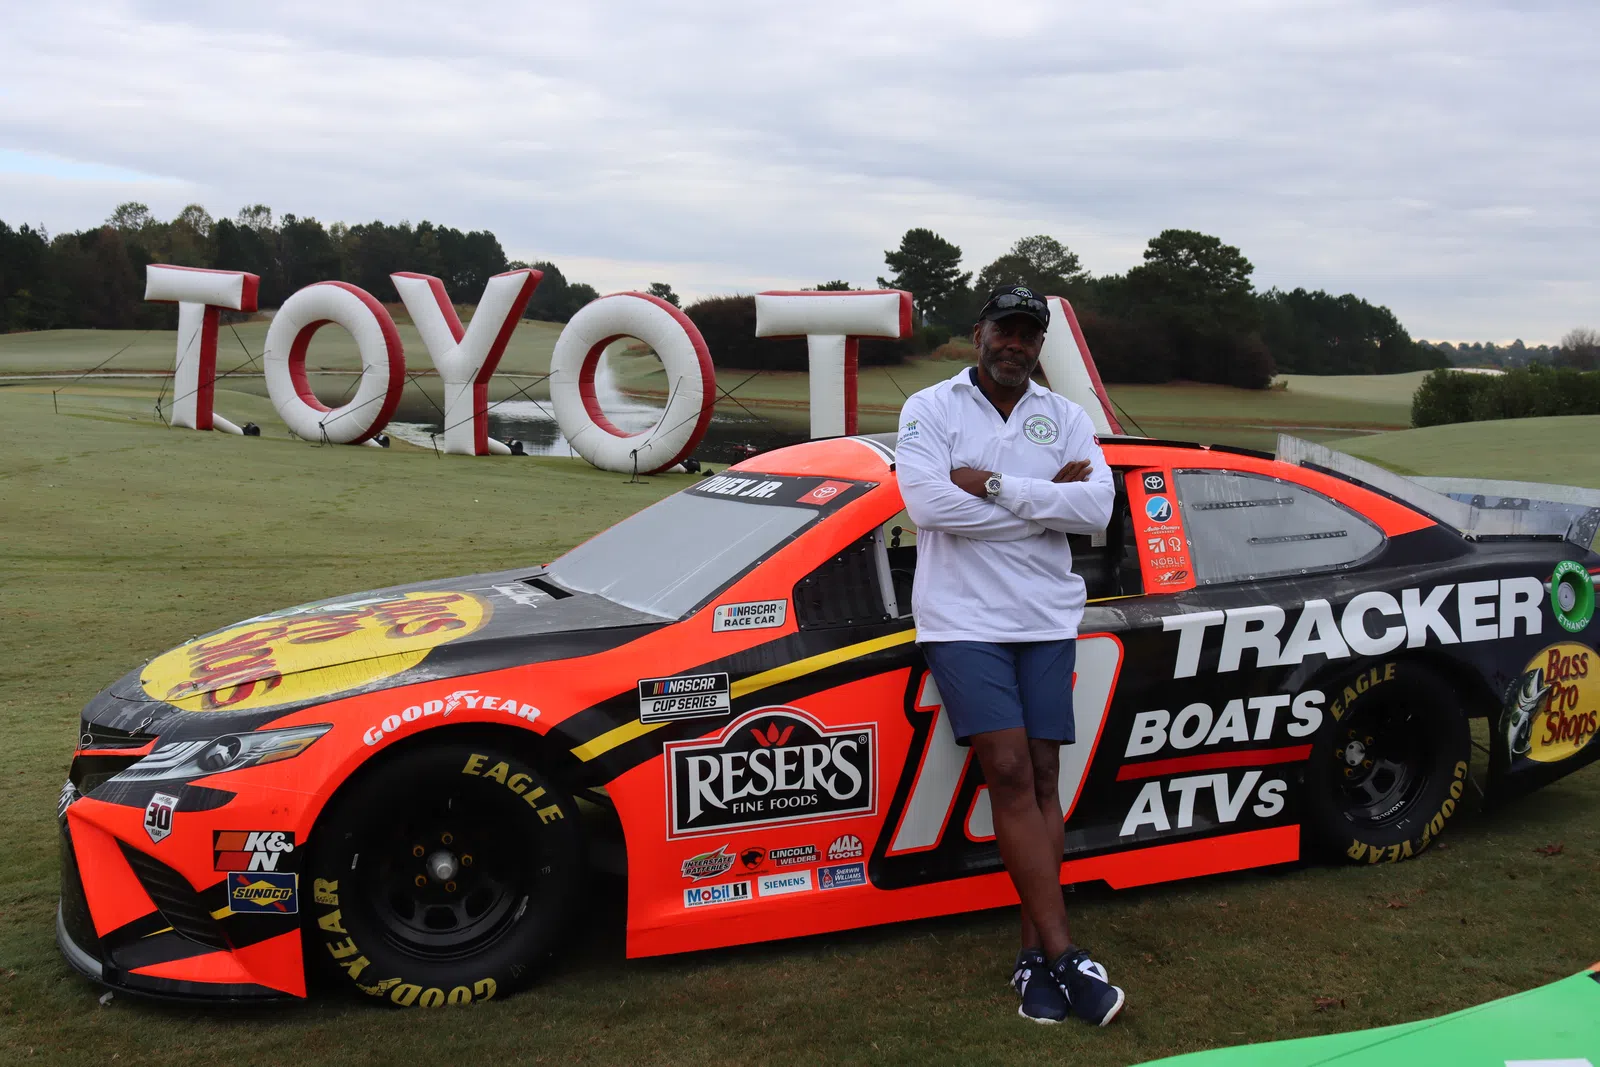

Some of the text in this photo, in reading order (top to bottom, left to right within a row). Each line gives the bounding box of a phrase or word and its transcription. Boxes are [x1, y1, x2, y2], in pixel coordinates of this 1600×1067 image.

[738, 480, 782, 498] JR.
[1151, 557, 1185, 567] NOBLE
[1555, 562, 1590, 583] AMERICAN
[736, 604, 777, 616] NASCAR
[723, 615, 776, 628] RACE CAR
[1162, 576, 1544, 679] TRACKER
[1557, 613, 1590, 631] ETHANOL
[1544, 648, 1589, 684] Bass
[667, 677, 716, 694] NASCAR
[1330, 662, 1397, 722] EAGLE
[652, 695, 717, 713] CUP SERIES
[1544, 681, 1580, 714] Pro
[1124, 689, 1326, 758] BOATS
[1541, 709, 1597, 747] Shops
[461, 753, 565, 825] EAGLE
[685, 737, 863, 824] RESER'S
[732, 794, 818, 814] FINE FOODS
[1380, 800, 1406, 818] TOYOTA
[146, 802, 172, 830] 30
[243, 831, 294, 853] K&
[828, 834, 863, 854] MAC
[247, 851, 281, 872] N
[684, 855, 734, 868] INTERSTATE
[771, 846, 813, 859] LINCOLN
[780, 854, 817, 865] WELDERS
[828, 850, 863, 860] TOOLS
[686, 864, 729, 875] BATTERIES
[834, 873, 862, 881] WILLIAMS
[836, 867, 860, 876] SHERWIN
[763, 876, 806, 890] SIEMENS
[235, 888, 291, 899] SUNOCO
[687, 884, 730, 903] Mobil
